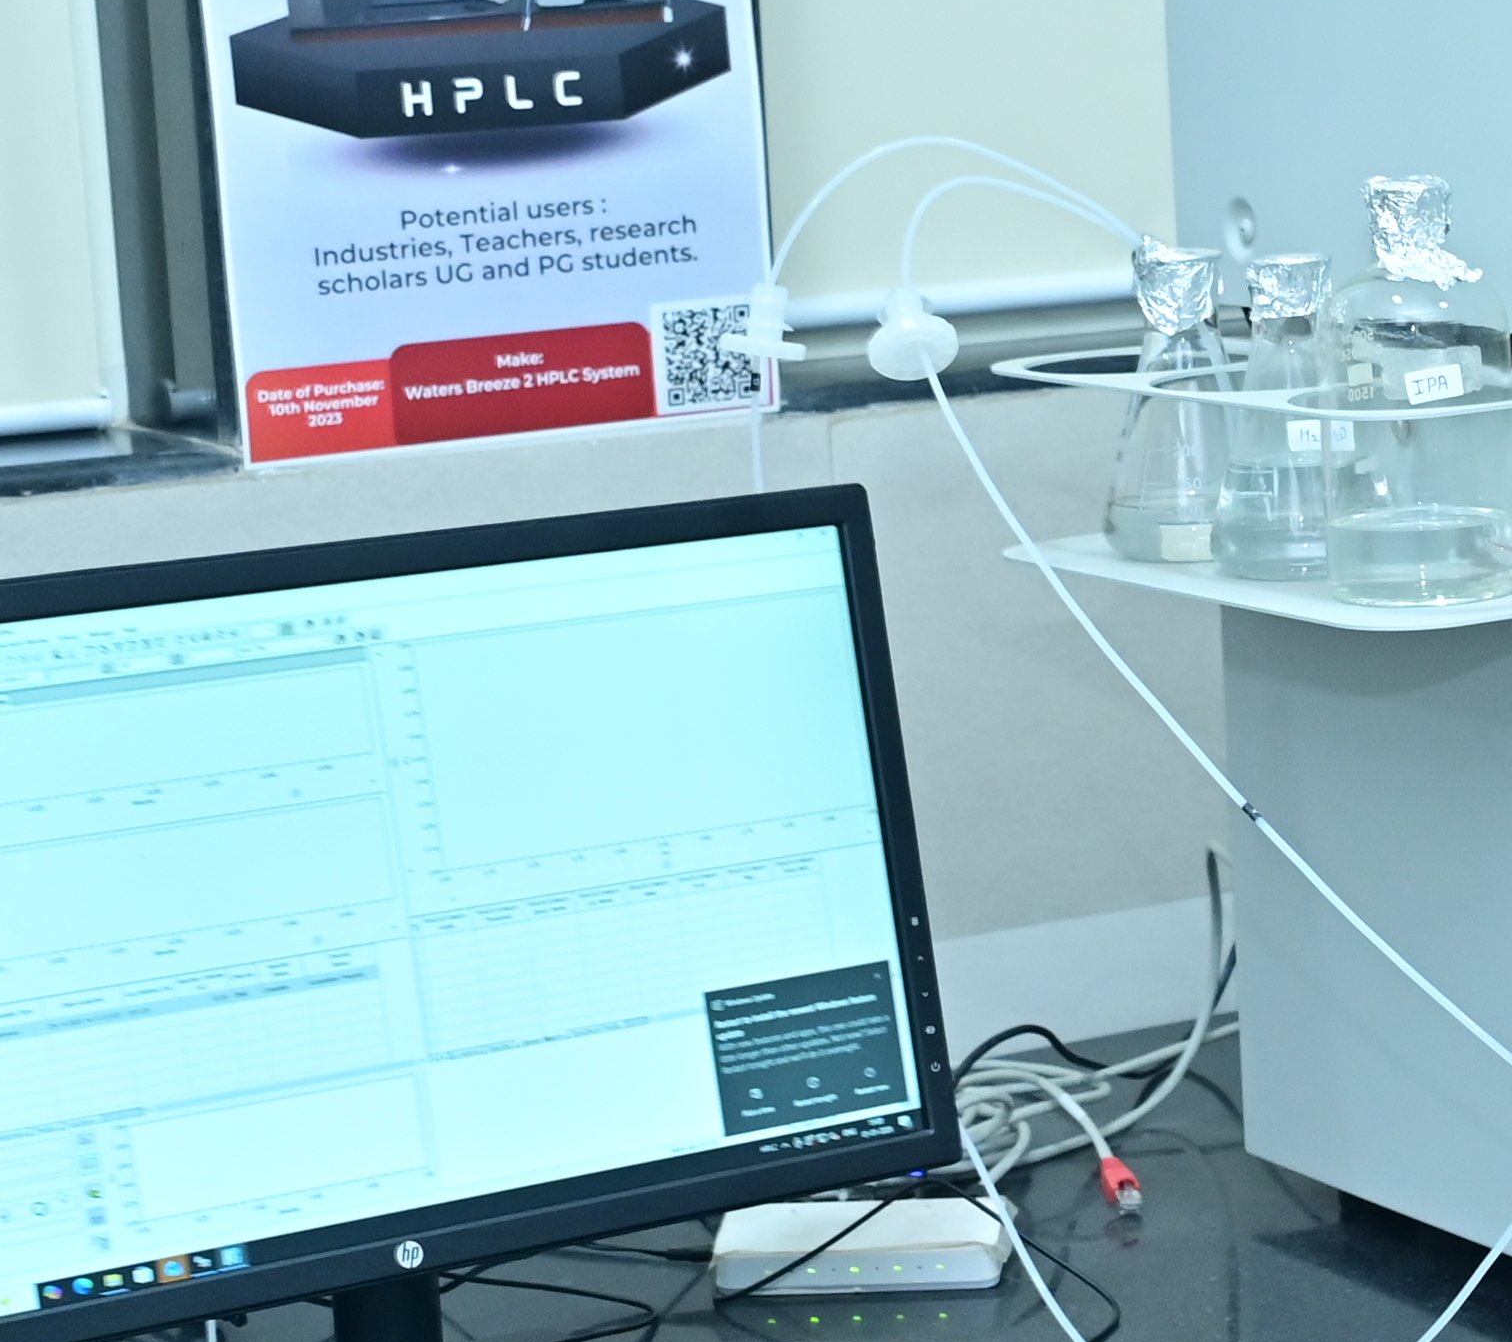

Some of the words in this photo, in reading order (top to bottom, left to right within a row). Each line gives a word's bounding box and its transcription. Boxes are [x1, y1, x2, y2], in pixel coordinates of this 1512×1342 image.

[400, 70, 584, 118] HPLC
[400, 201, 518, 230] Potential
[527, 198, 594, 219] users
[314, 237, 453, 267] Industries,
[459, 228, 583, 254] Teachers,
[589, 215, 697, 242] research
[317, 267, 428, 296] scholars
[435, 263, 474, 284] UG
[482, 257, 530, 281] and
[539, 255, 574, 276] PG
[582, 244, 698, 271] students.
[495, 352, 544, 369] Make:
[257, 388, 293, 403] Date
[296, 385, 311, 399] of
[314, 380, 385, 397] Purchase:
[403, 383, 464, 400] Waters
[466, 376, 520, 394] Breeze
[523, 374, 535, 388] 2
[537, 368, 579, 386] HPLC
[582, 364, 640, 384] System
[1412, 375, 1448, 396] IPA
[269, 402, 301, 417] 10th
[304, 395, 379, 413] November
[308, 412, 343, 428] 2023
[400, 1241, 421, 1268] hp
